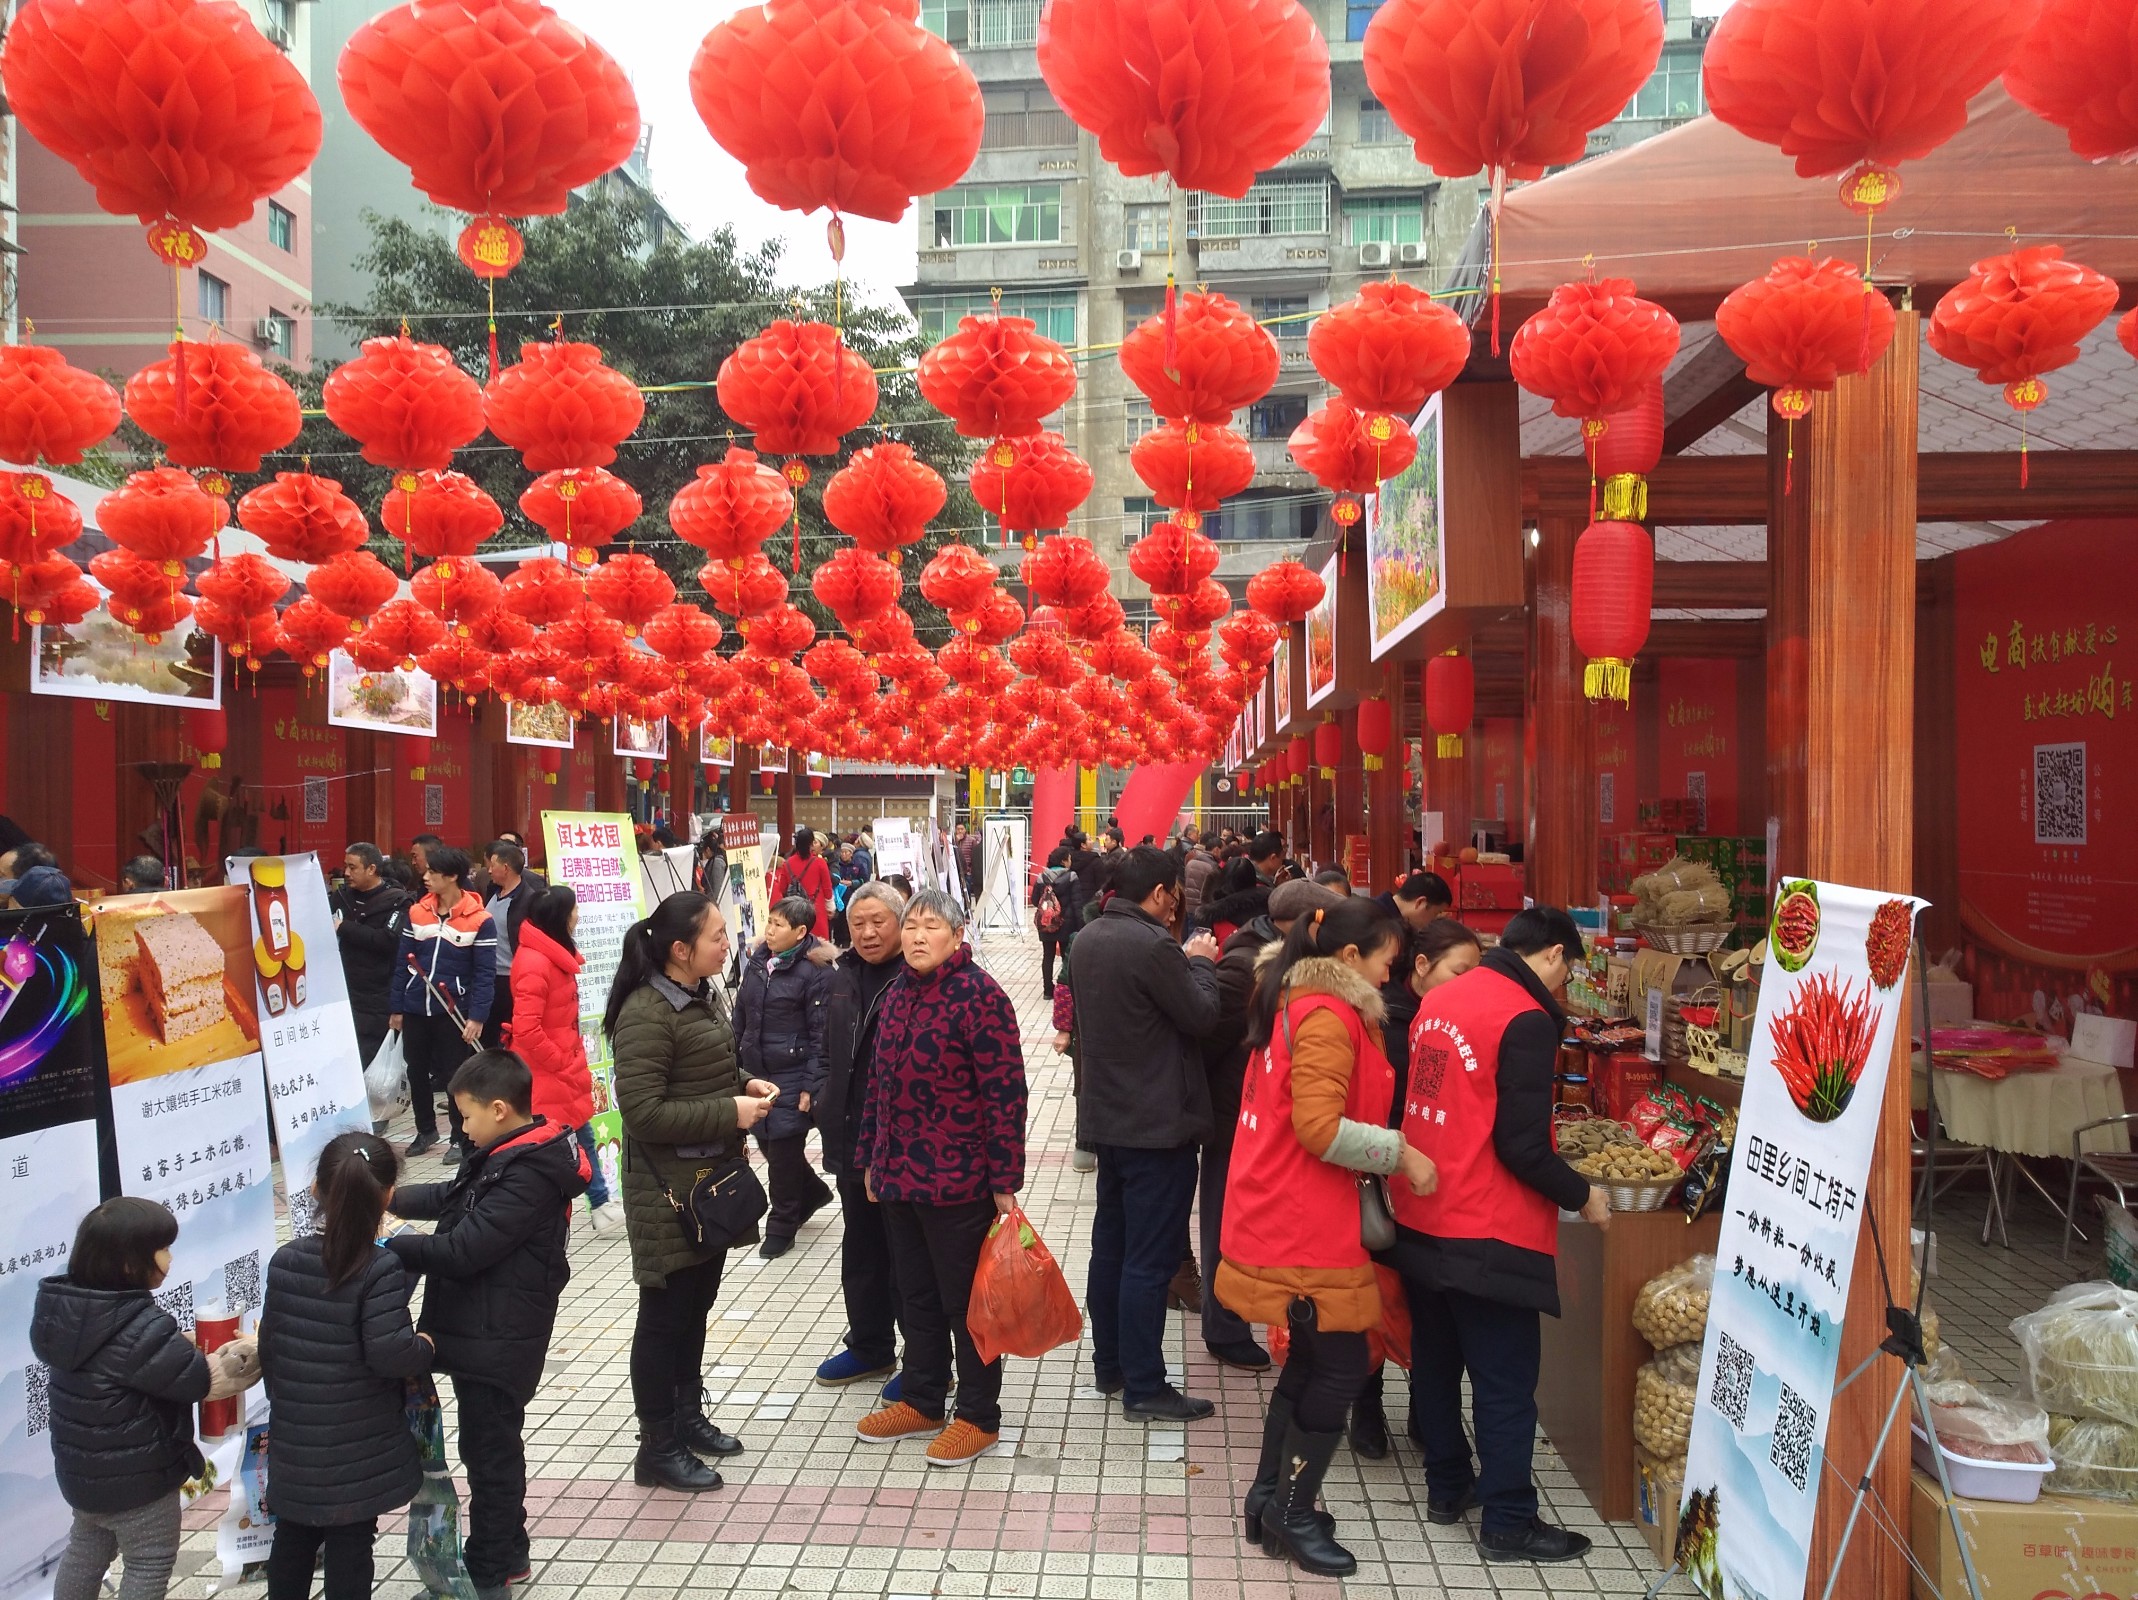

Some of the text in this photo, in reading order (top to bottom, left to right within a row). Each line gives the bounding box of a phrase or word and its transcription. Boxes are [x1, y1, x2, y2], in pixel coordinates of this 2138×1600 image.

[163, 233, 194, 260] 福
[1781, 391, 1805, 412] 福
[2015, 381, 2039, 403] 福
[1188, 427, 1198, 443] 福
[788, 466, 806, 484] 福
[22, 478, 46, 499] 福
[207, 479, 226, 494] 福
[560, 480, 578, 497] 福
[1338, 503, 1355, 521] 福
[437, 562, 451, 579] 福
[965, 619, 979, 632] 福
[1980, 620, 2117, 673] 电商扶贫献爱心
[557, 822, 622, 849] 闰土农园
[562, 857, 621, 878] 珍贵源于自然
[576, 881, 632, 904] 品味归于香鲜
[273, 1019, 321, 1047] 田间地头
[1406, 1099, 1447, 1126] 水电商
[11, 1154, 30, 1180] 道
[1746, 1135, 1857, 1222] 田里乡间土特产
[2023, 1544, 2069, 1558] 百草味
